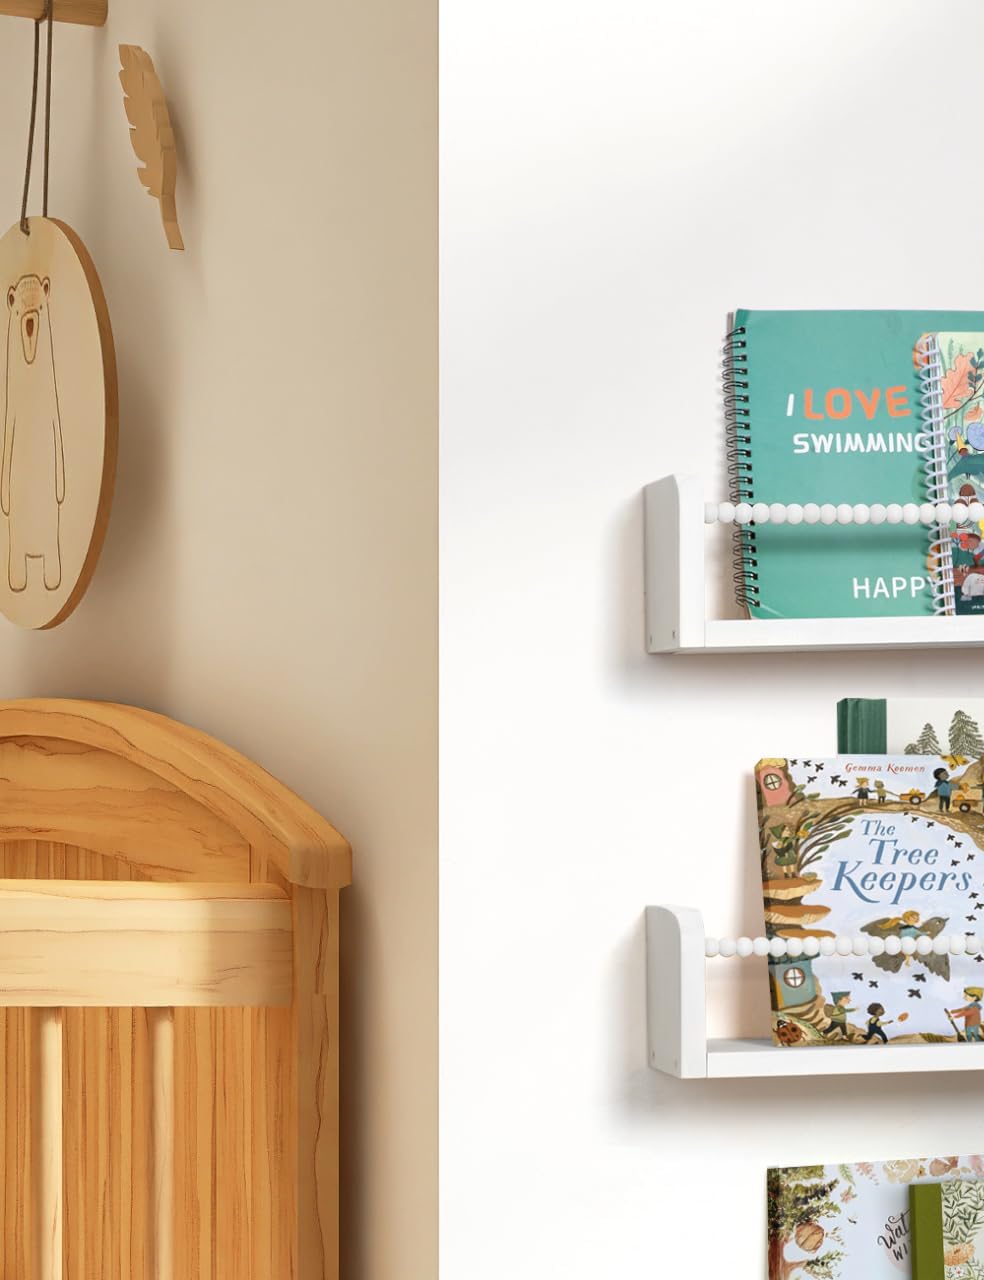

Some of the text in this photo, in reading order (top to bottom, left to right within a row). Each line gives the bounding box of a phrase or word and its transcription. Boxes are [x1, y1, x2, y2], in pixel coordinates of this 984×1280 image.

[786, 384, 913, 421] I LOVE
[845, 763, 882, 774] Gemma
[861, 819, 896, 836] The
[869, 838, 939, 866] Tree
[830, 860, 972, 905] Keepers
